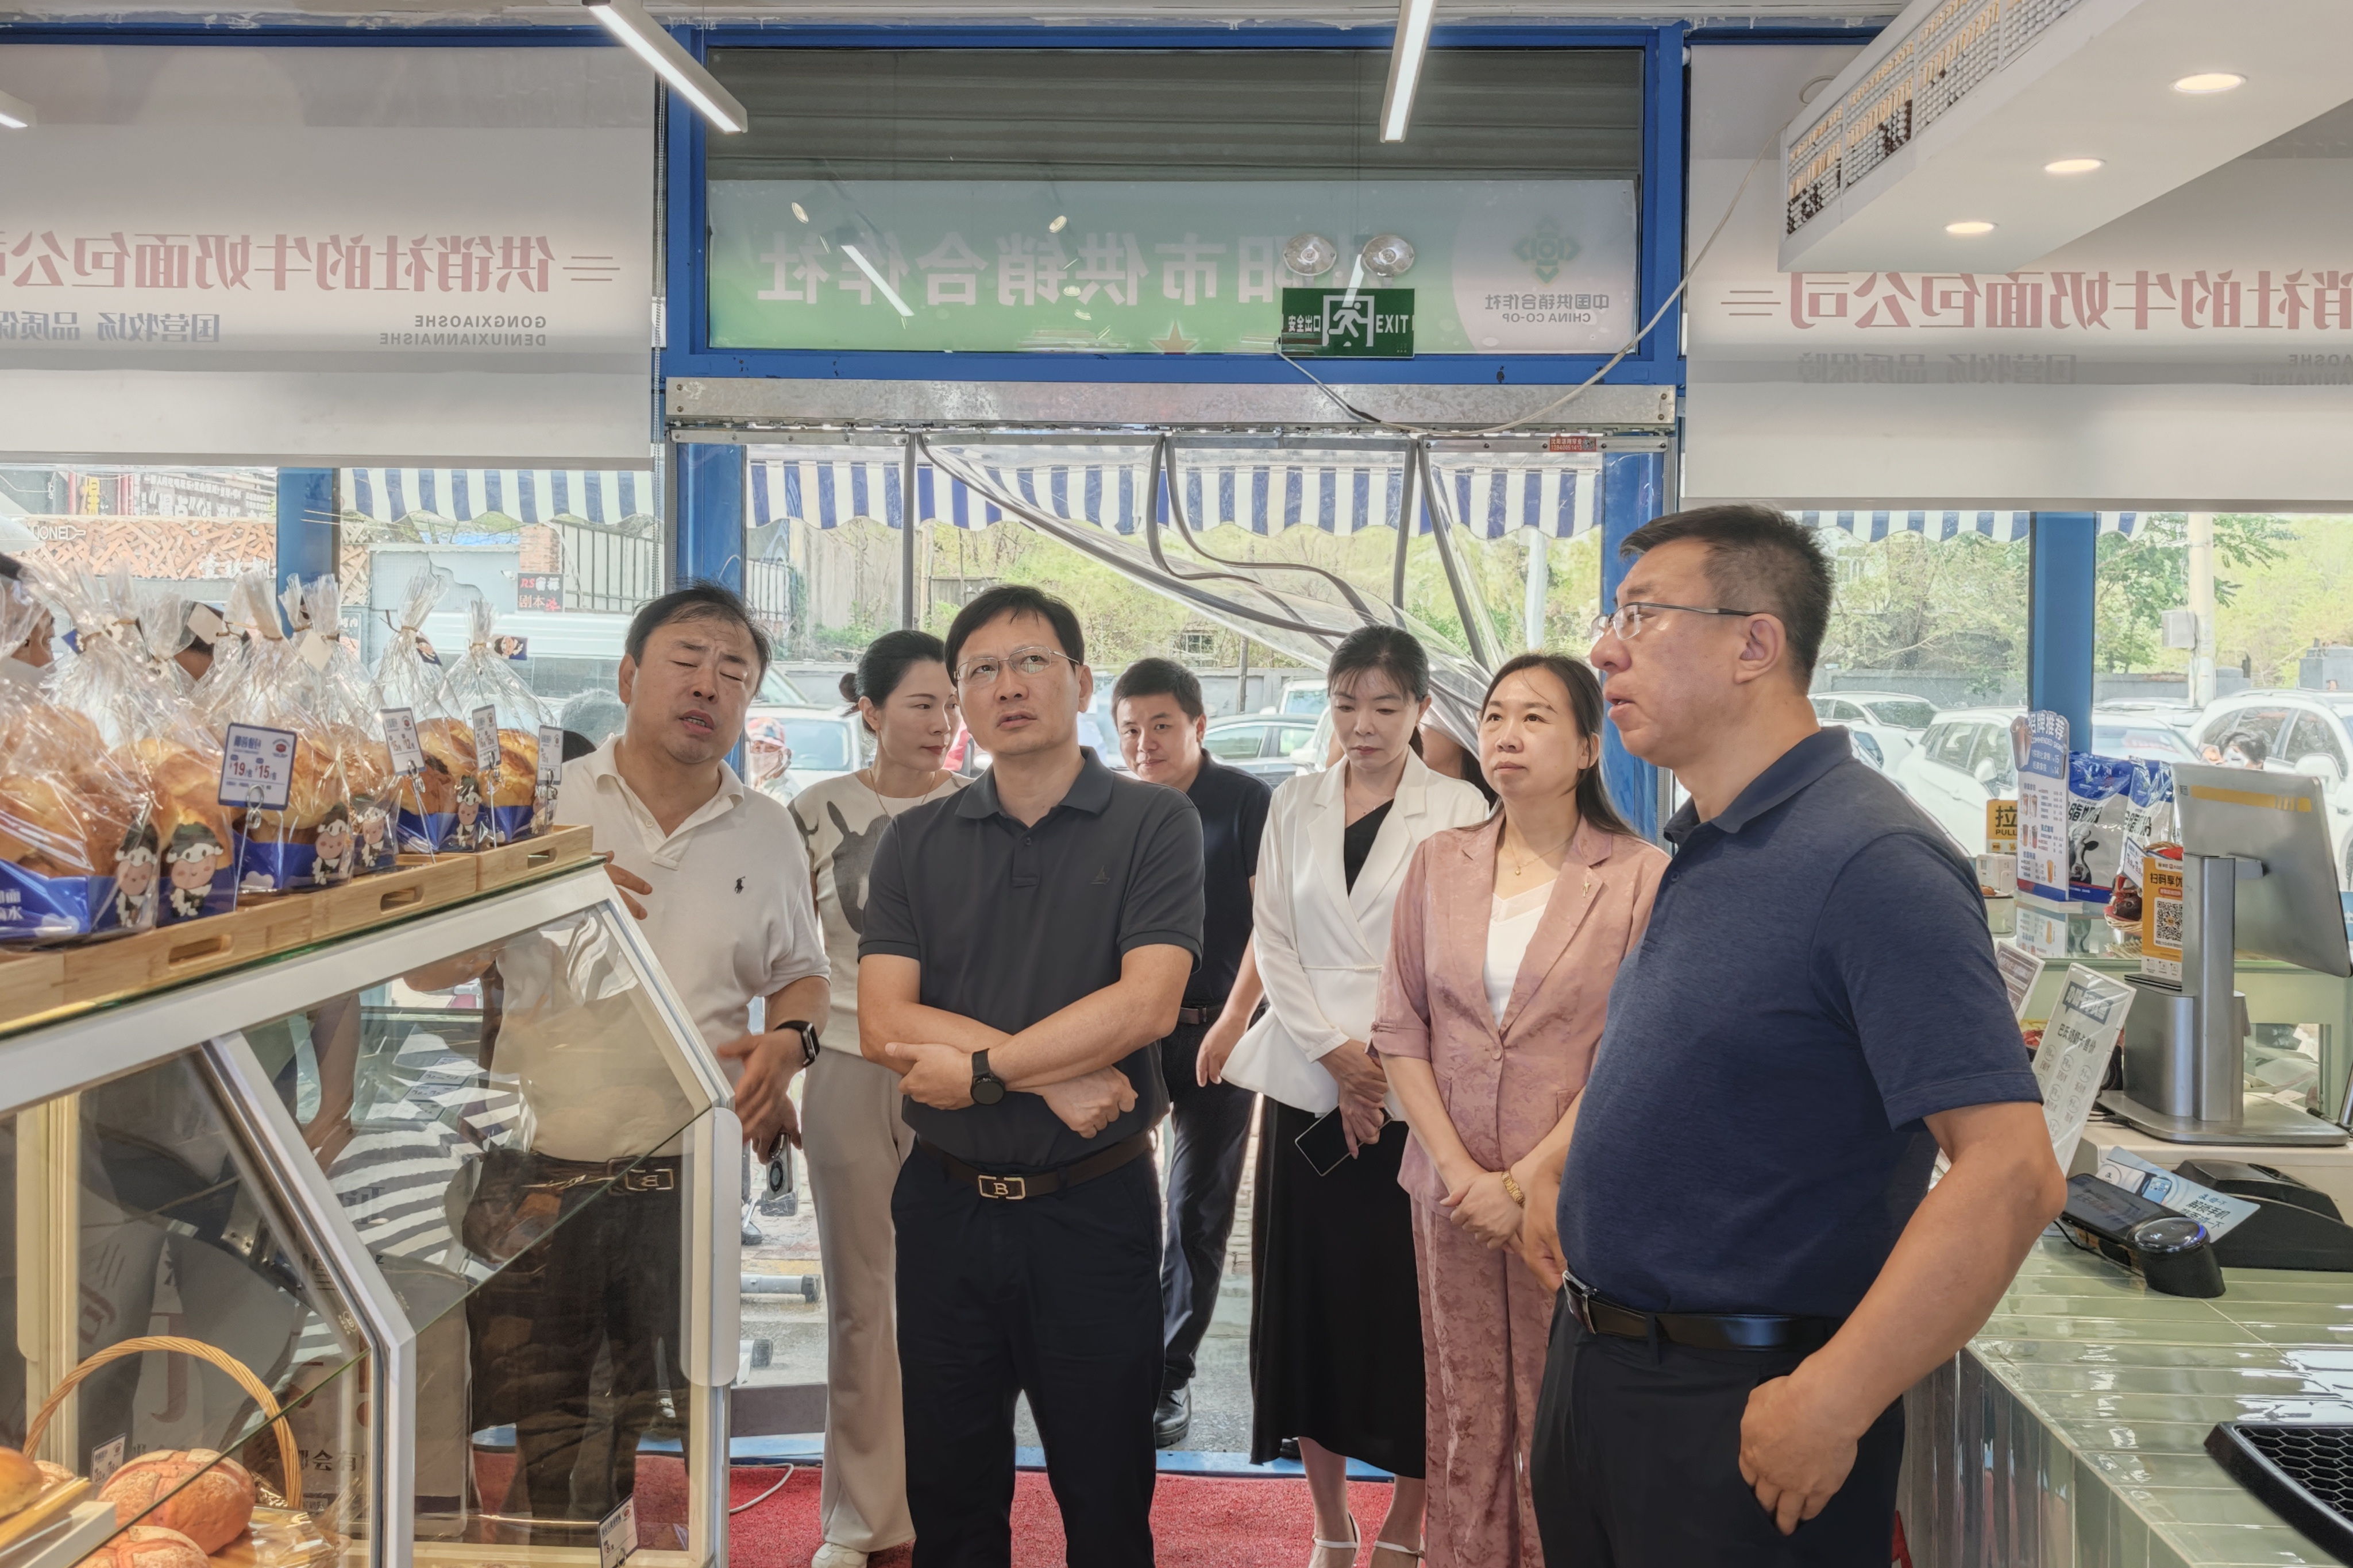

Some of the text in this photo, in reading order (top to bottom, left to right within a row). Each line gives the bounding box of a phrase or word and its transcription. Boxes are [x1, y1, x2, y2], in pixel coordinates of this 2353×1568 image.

[1289, 315, 1321, 333] 安全出口
[1376, 315, 1409, 333] EXIT
[1995, 805, 2018, 827] 拉
[2185, 1200, 2231, 1219] 解锁手机
